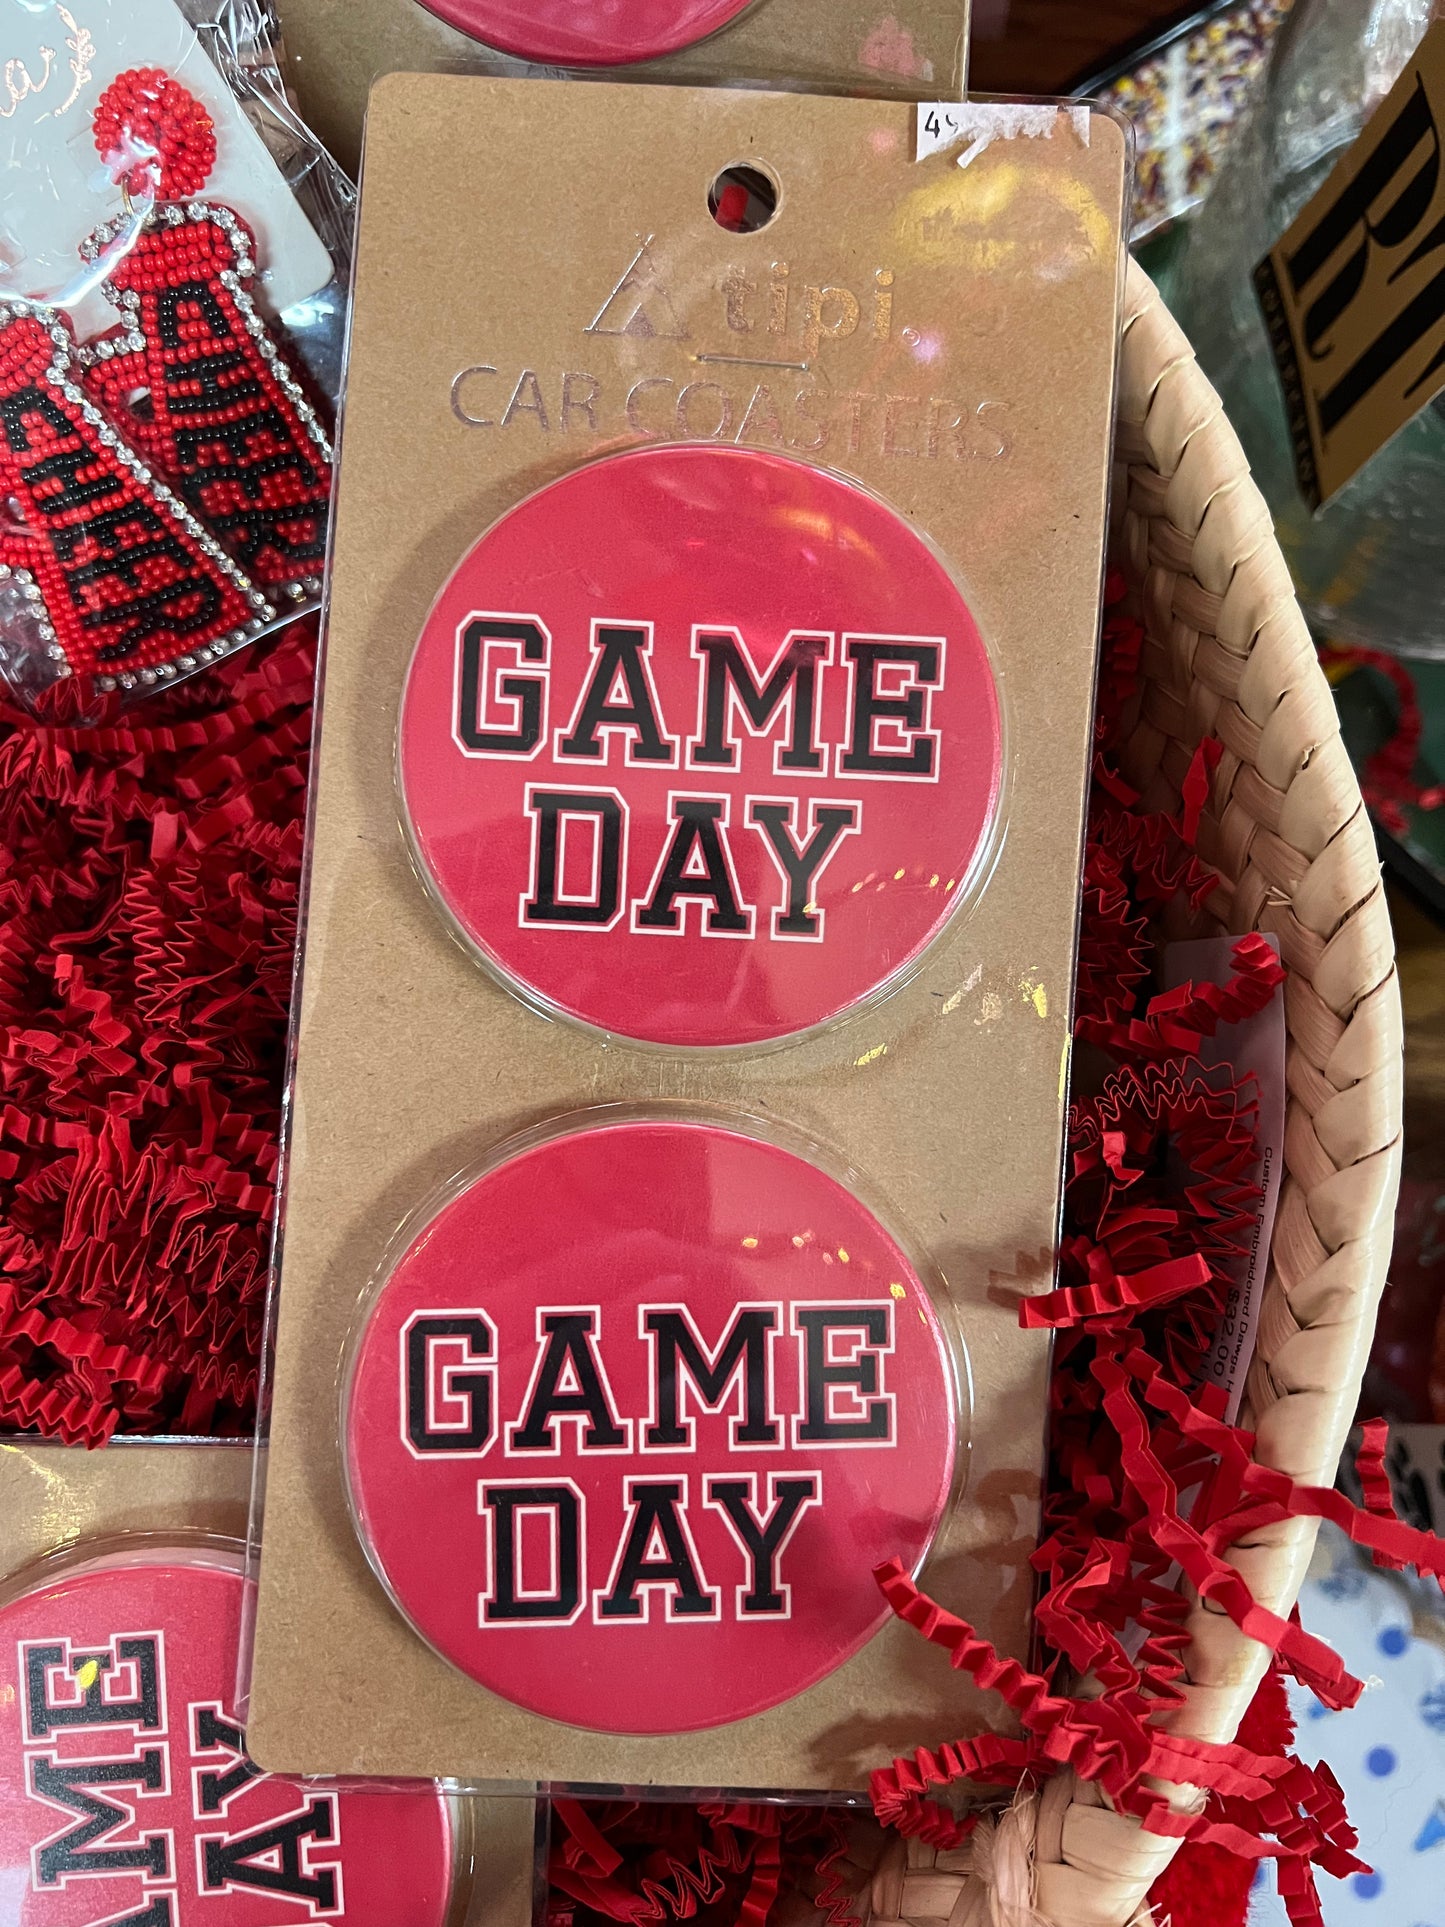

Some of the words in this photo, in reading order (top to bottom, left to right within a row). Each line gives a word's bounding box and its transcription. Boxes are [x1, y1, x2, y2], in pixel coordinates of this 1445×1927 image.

[721, 260, 895, 357] tipi
[450, 365, 600, 433] CAR
[626, 377, 1011, 461] COASTERS
[4, 384, 222, 659] CHEER
[452, 610, 947, 783] GAME
[518, 782, 863, 943] DAY
[1258, 1147, 1274, 1208] Custom
[400, 1300, 897, 1460] GAME
[1212, 1288, 1241, 1378] $32.00
[1228, 1322, 1249, 1375] Dawgs
[478, 1470, 822, 1629] DAY
